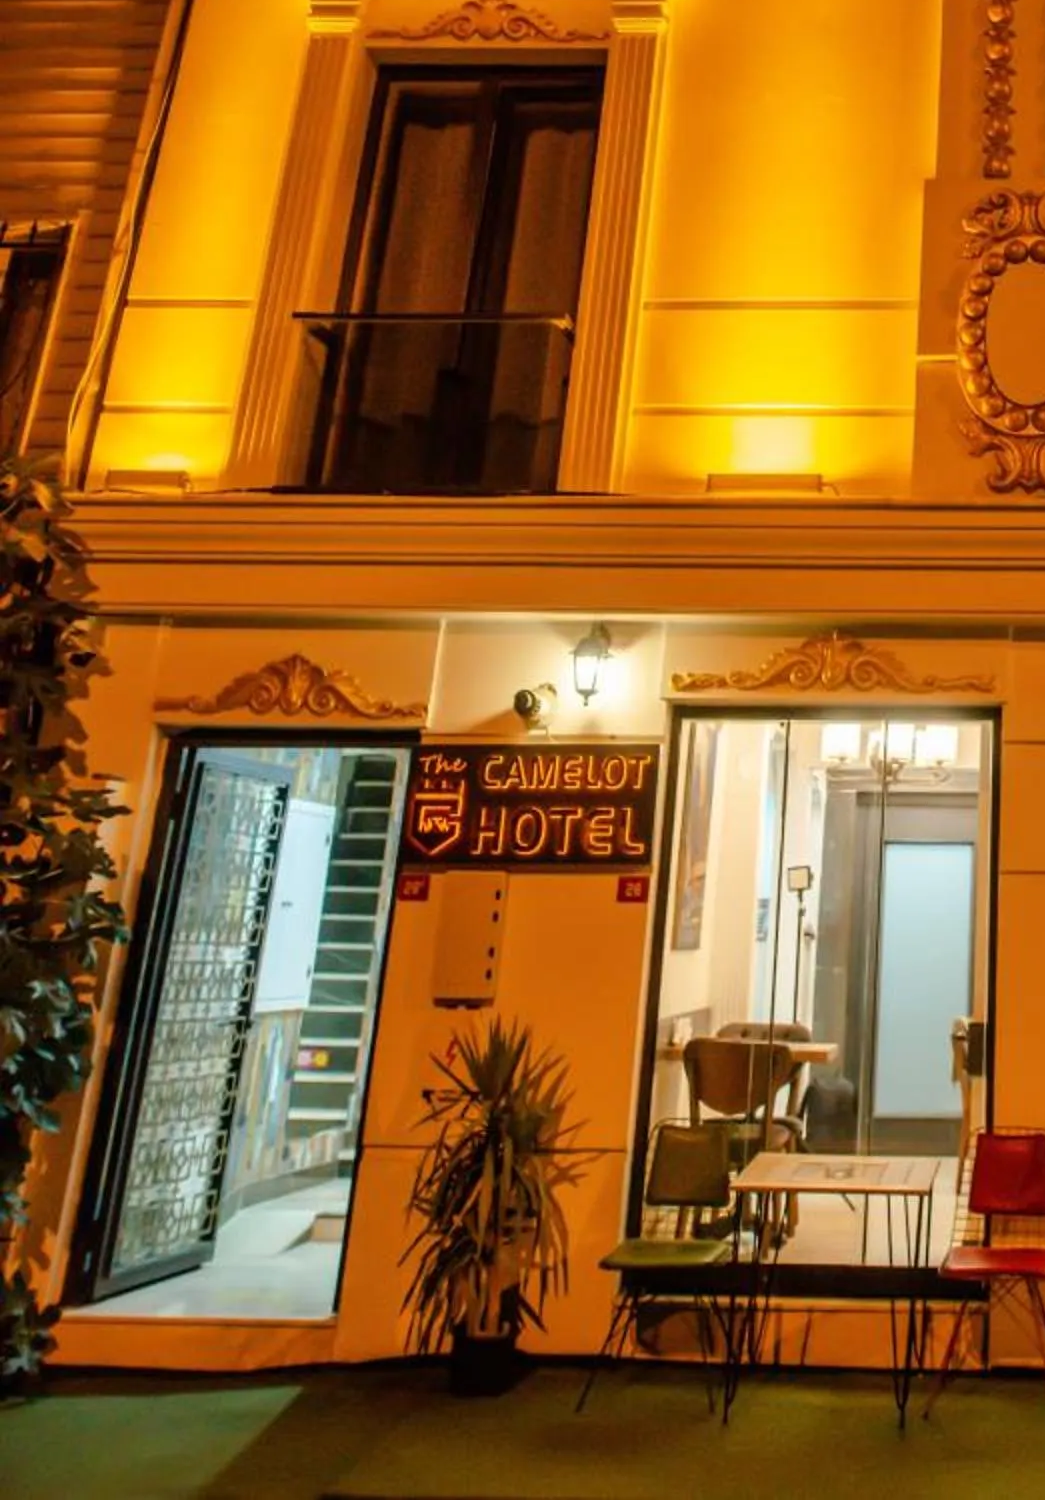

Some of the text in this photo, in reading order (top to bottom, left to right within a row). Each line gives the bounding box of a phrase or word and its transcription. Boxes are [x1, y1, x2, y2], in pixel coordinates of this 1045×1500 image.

[419, 753, 651, 790] The CAMELOT
[470, 806, 646, 856] HOTEL
